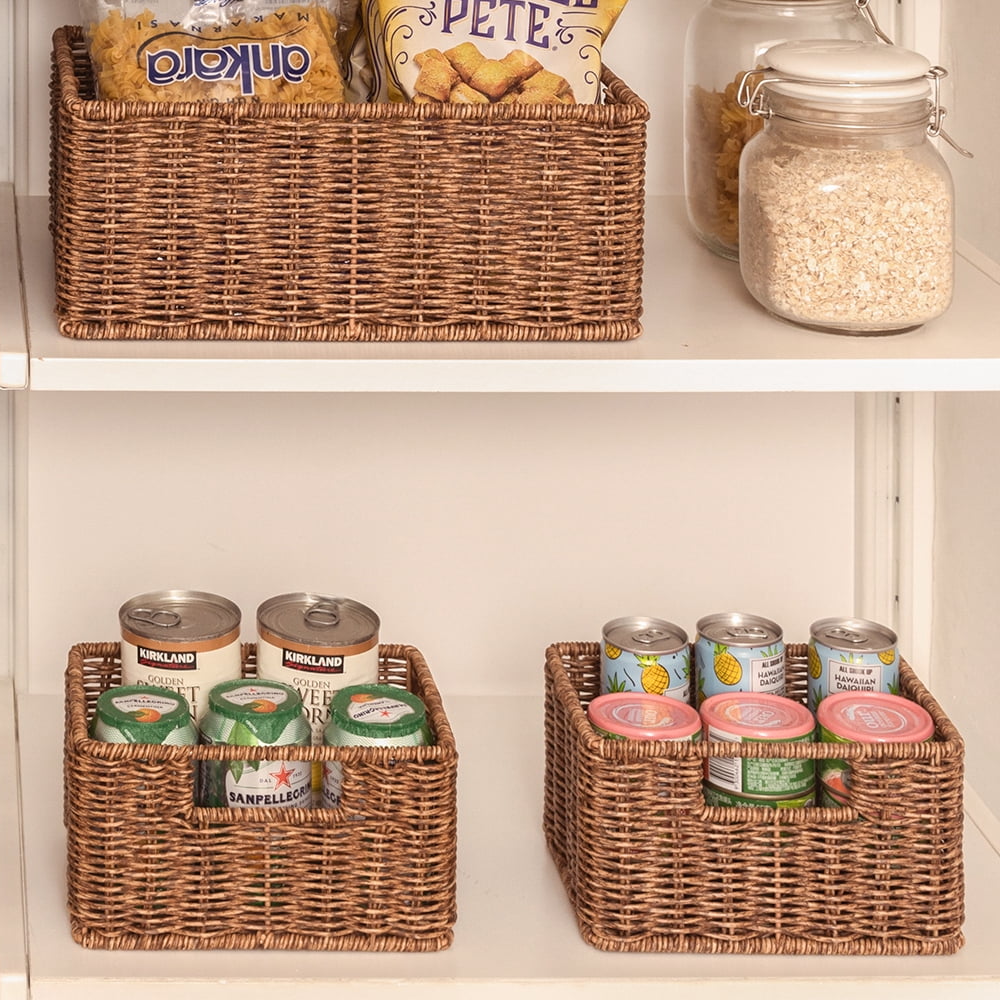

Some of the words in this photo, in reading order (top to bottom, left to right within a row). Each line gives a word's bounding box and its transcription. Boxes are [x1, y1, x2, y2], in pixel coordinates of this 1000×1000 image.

[137, 12, 309, 33] MAKARNASI
[146, 42, 311, 96] ankara
[139, 648, 194, 664] KIRKLAND
[285, 650, 342, 667] KIRKLAND
[148, 674, 184, 685] GOLDEN
[293, 677, 331, 689] GOLDEN
[834, 674, 876, 685] HAWAIIAN
